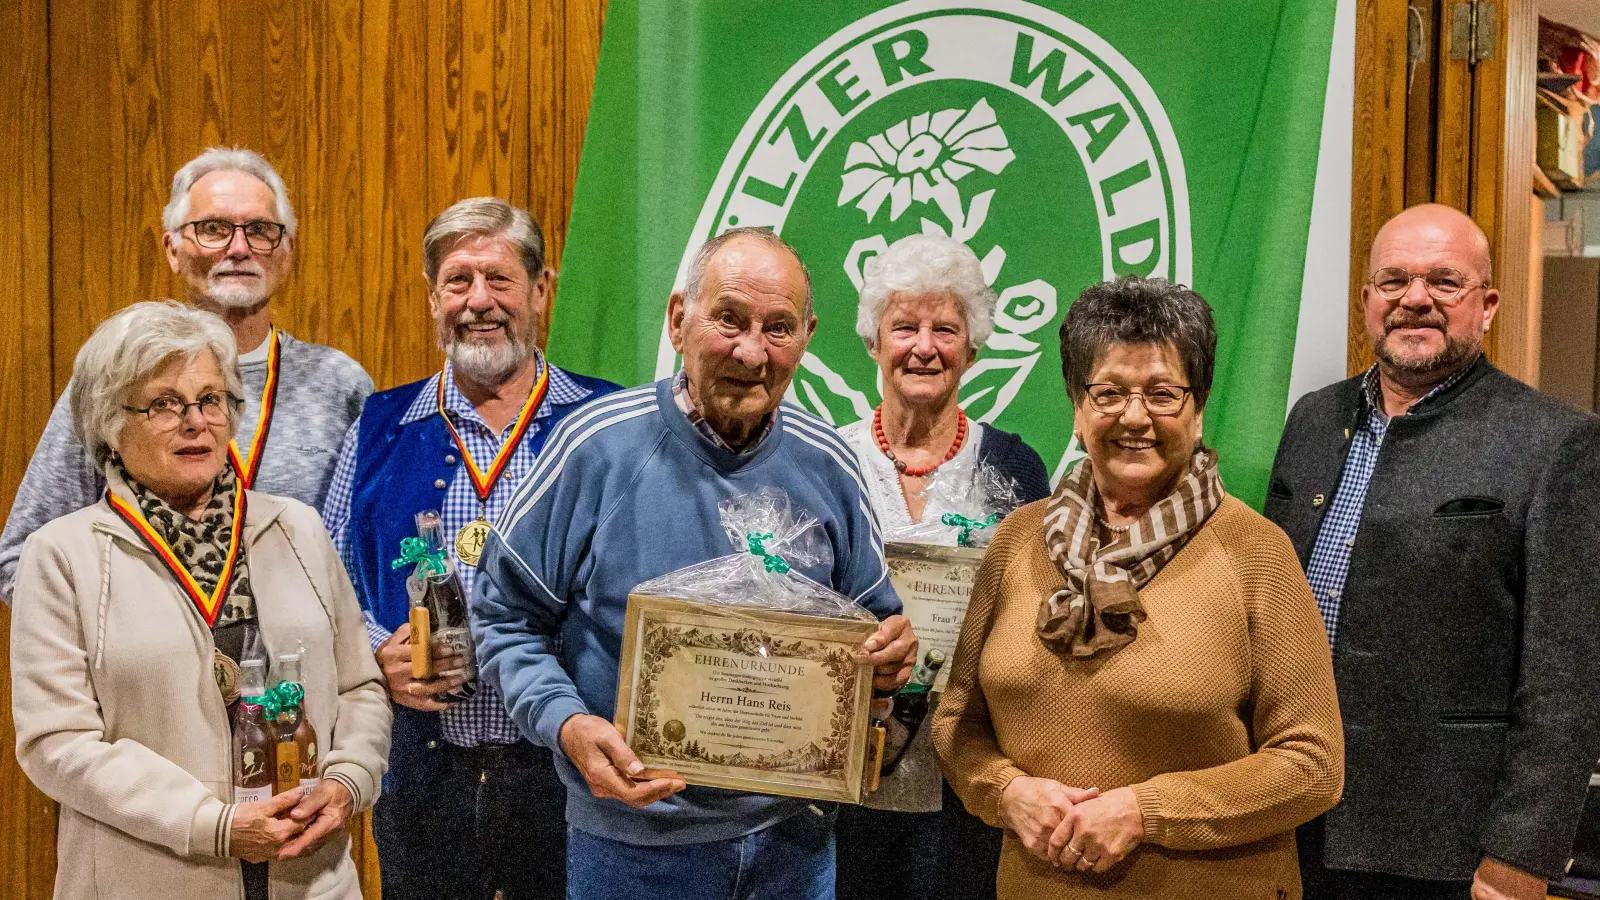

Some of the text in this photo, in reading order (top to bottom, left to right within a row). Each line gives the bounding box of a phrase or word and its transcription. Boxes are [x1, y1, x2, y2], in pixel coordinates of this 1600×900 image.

[726, 28, 1161, 278] LZER WALD
[914, 580, 973, 596] EHRENUR
[931, 613, 951, 624] Frau
[694, 654, 805, 676] EHRENURKUNDE
[700, 691, 791, 711] Herrn Hans Reis
